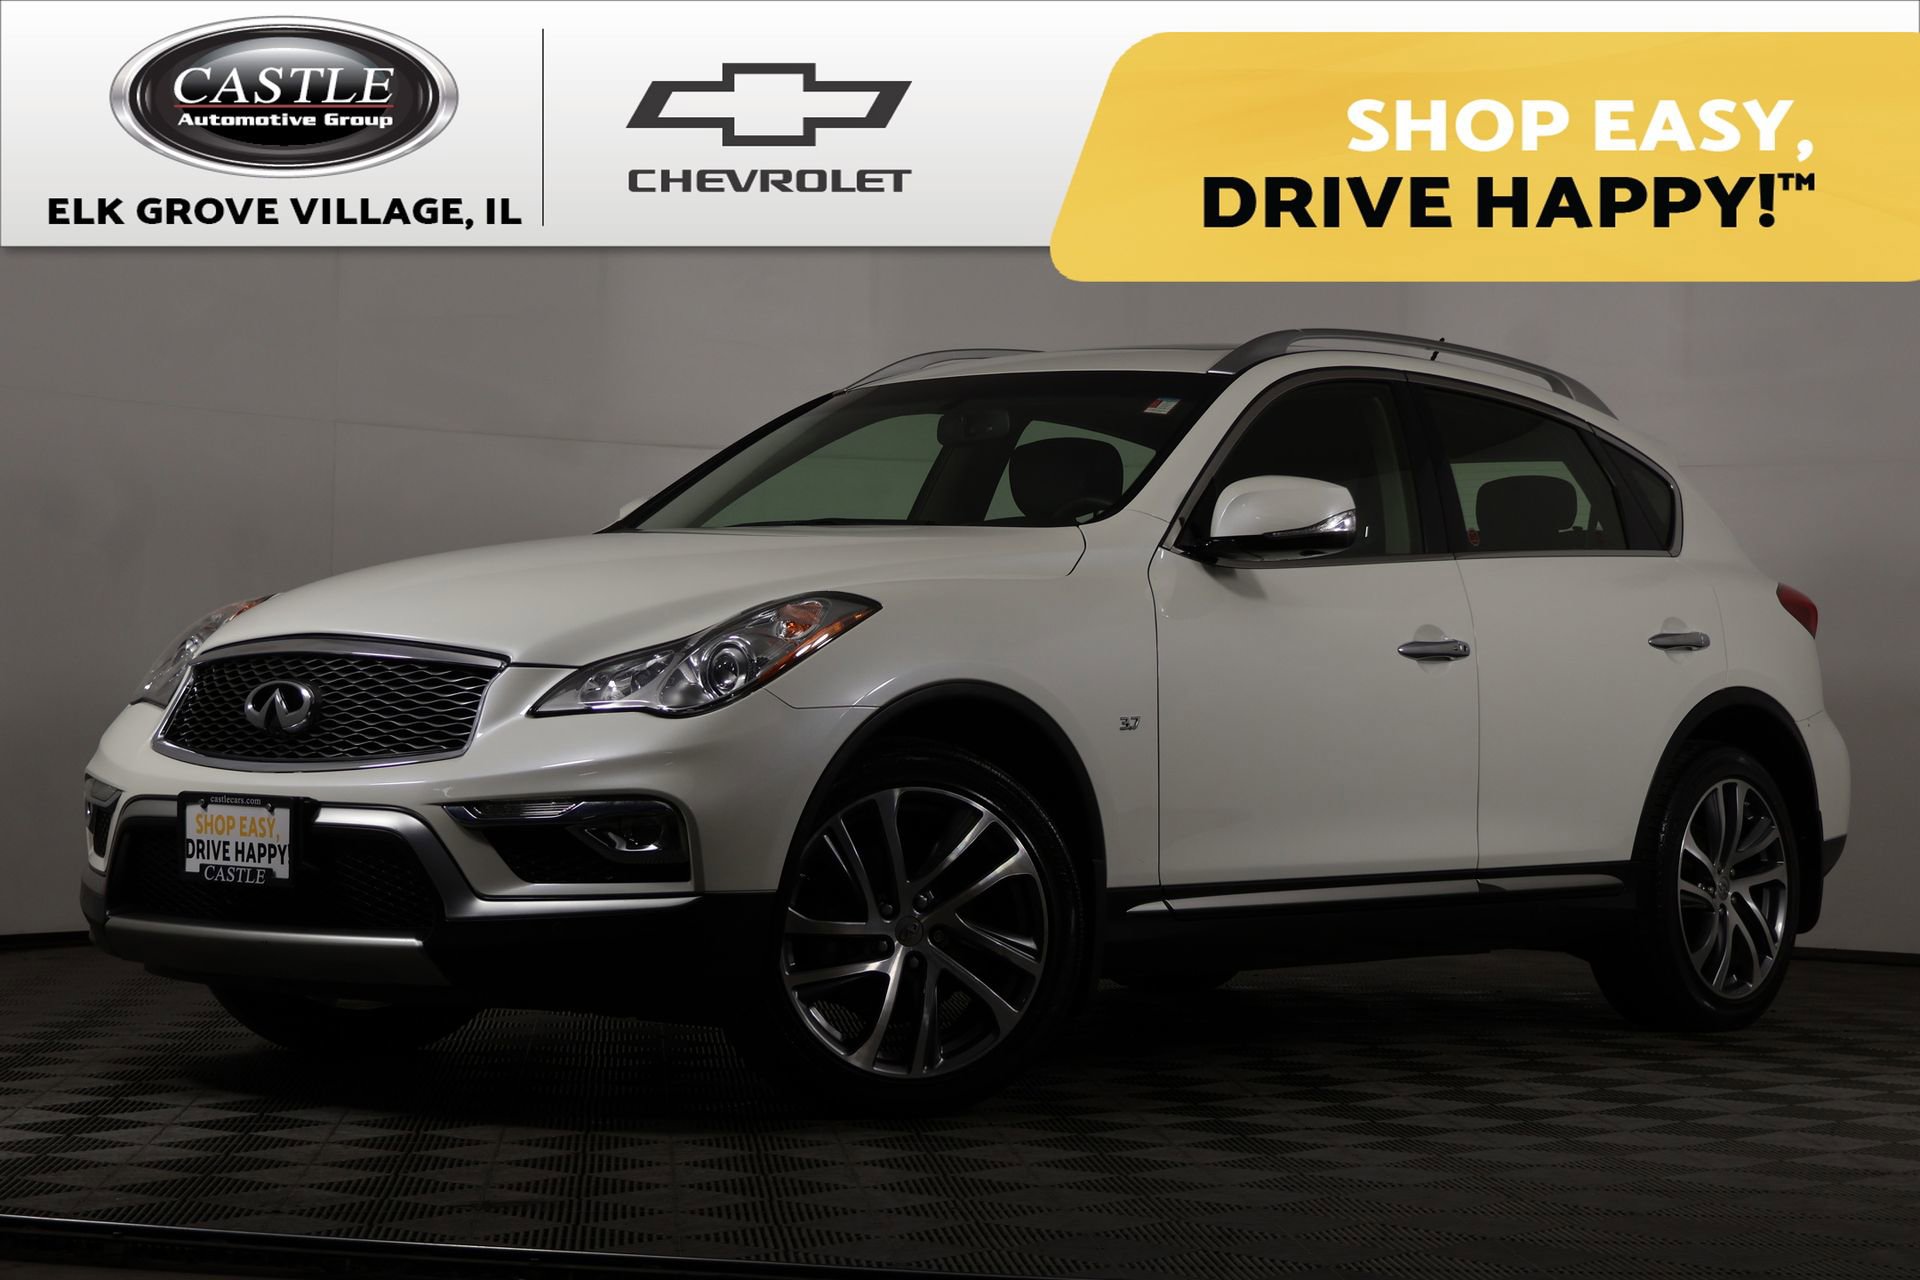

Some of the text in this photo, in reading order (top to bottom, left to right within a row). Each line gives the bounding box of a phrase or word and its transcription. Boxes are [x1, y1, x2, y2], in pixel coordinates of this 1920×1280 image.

[210, 795, 262, 805] castlecars.com
[195, 813, 280, 842] SHOP EASY,
[186, 838, 231, 861] DRIVE
[204, 865, 266, 884] CASTLE
